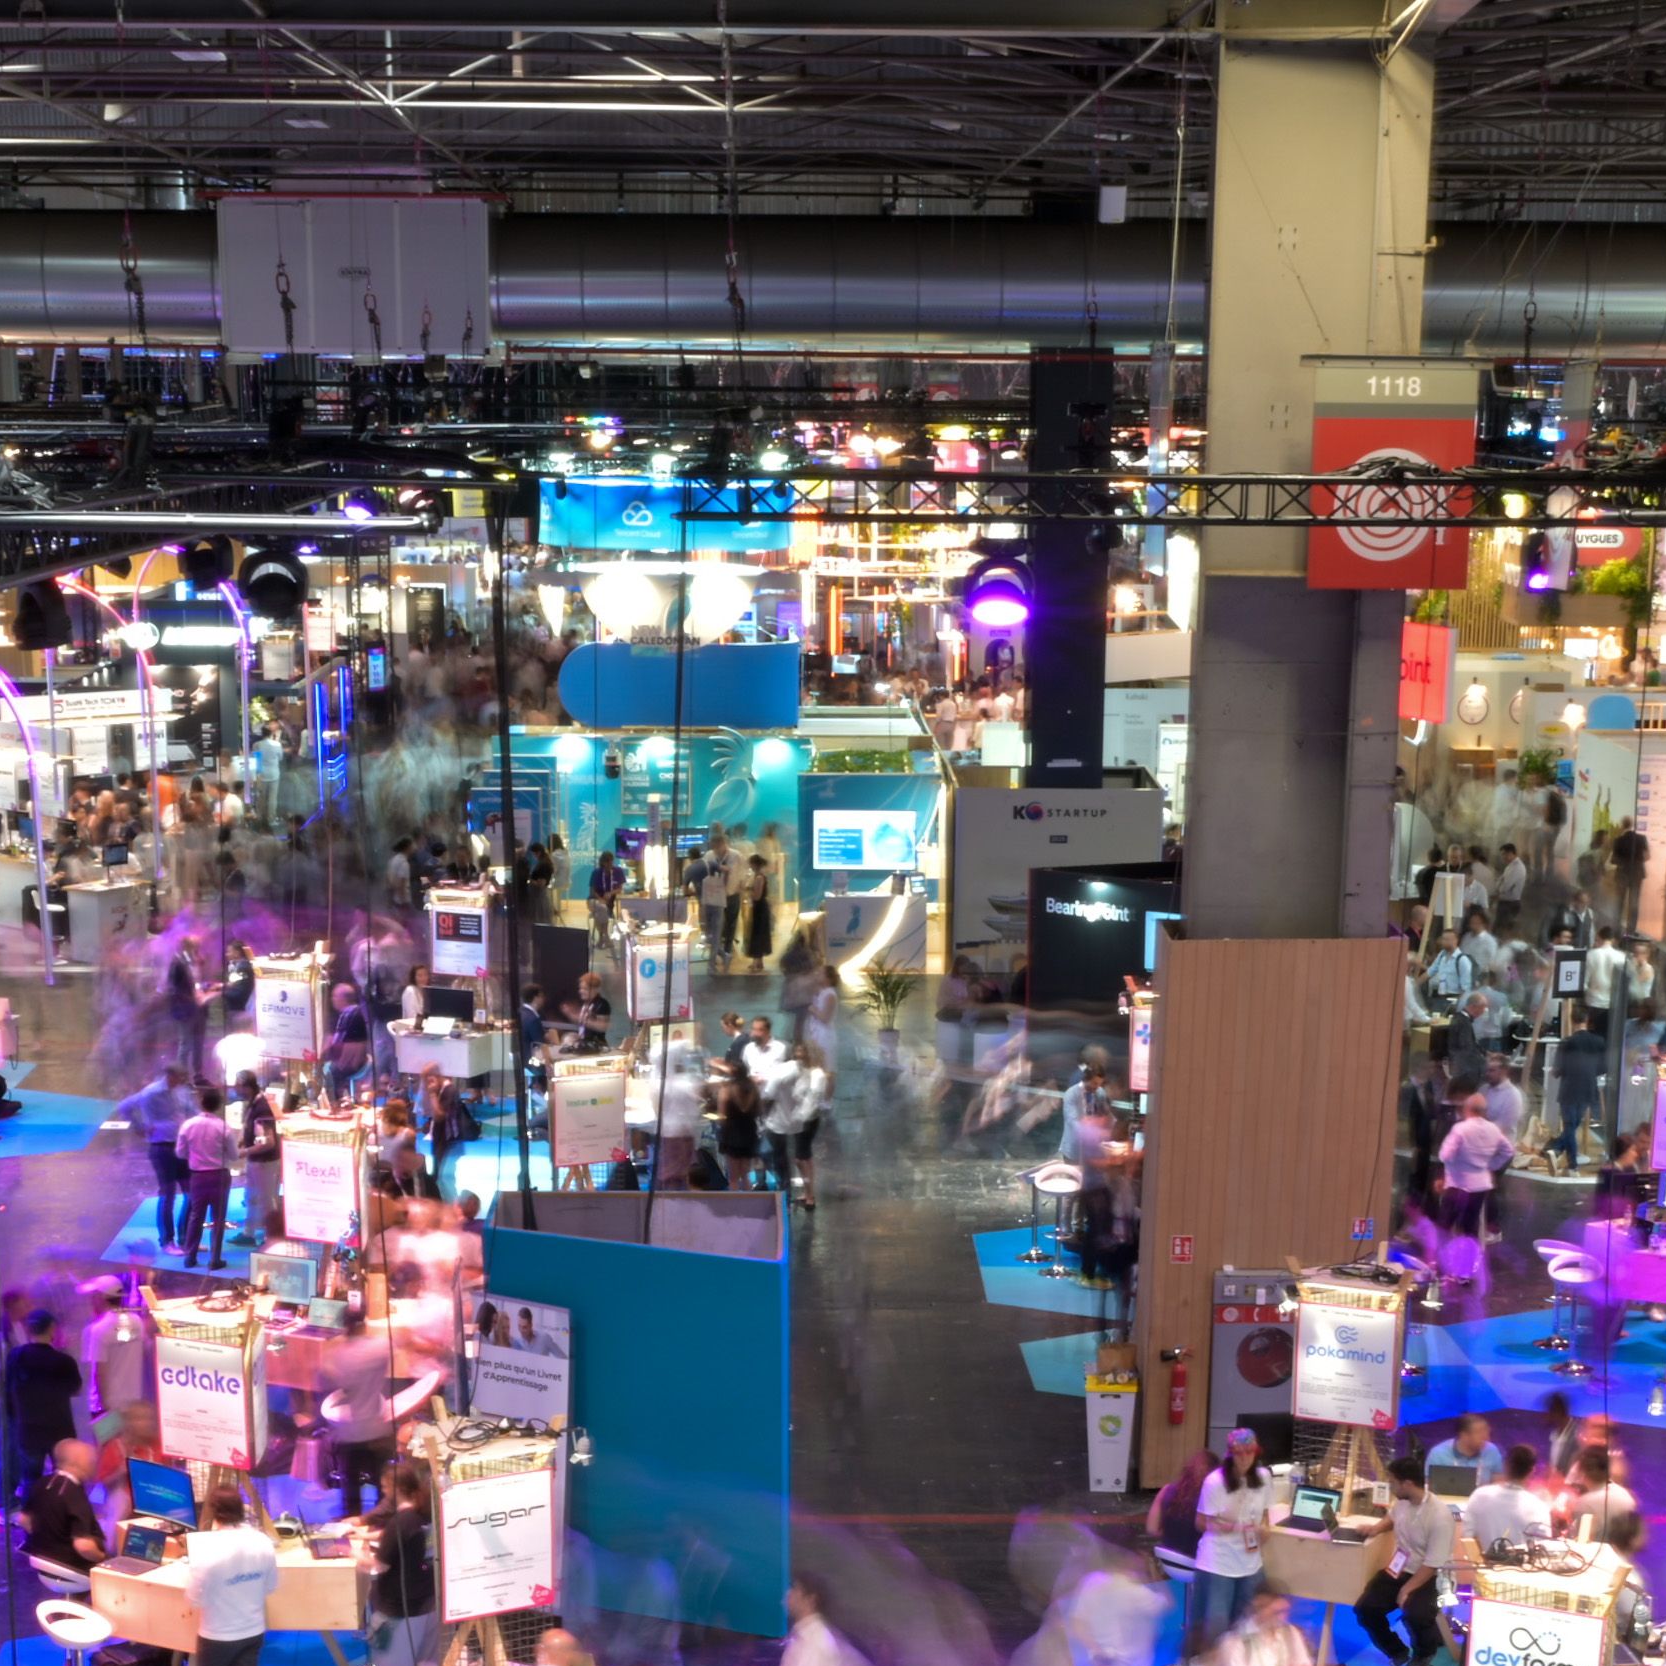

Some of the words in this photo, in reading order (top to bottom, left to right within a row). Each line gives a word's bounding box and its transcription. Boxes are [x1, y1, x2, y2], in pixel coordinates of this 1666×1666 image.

[1366, 376, 1422, 397] 1118
[629, 635, 701, 649] CALEDONAN
[1046, 807, 1109, 818] STARTUP
[1045, 897, 1130, 923] BearingPoint
[261, 1003, 306, 1018] EFIMOVE
[1305, 1341, 1386, 1366] pokamind
[160, 1365, 242, 1396] edtake
[482, 1370, 549, 1392] d'Apprentissage
[494, 1360, 513, 1373] plus
[513, 1364, 536, 1378] qu'un
[537, 1368, 563, 1383] Livret
[446, 1504, 547, 1530] sugar
